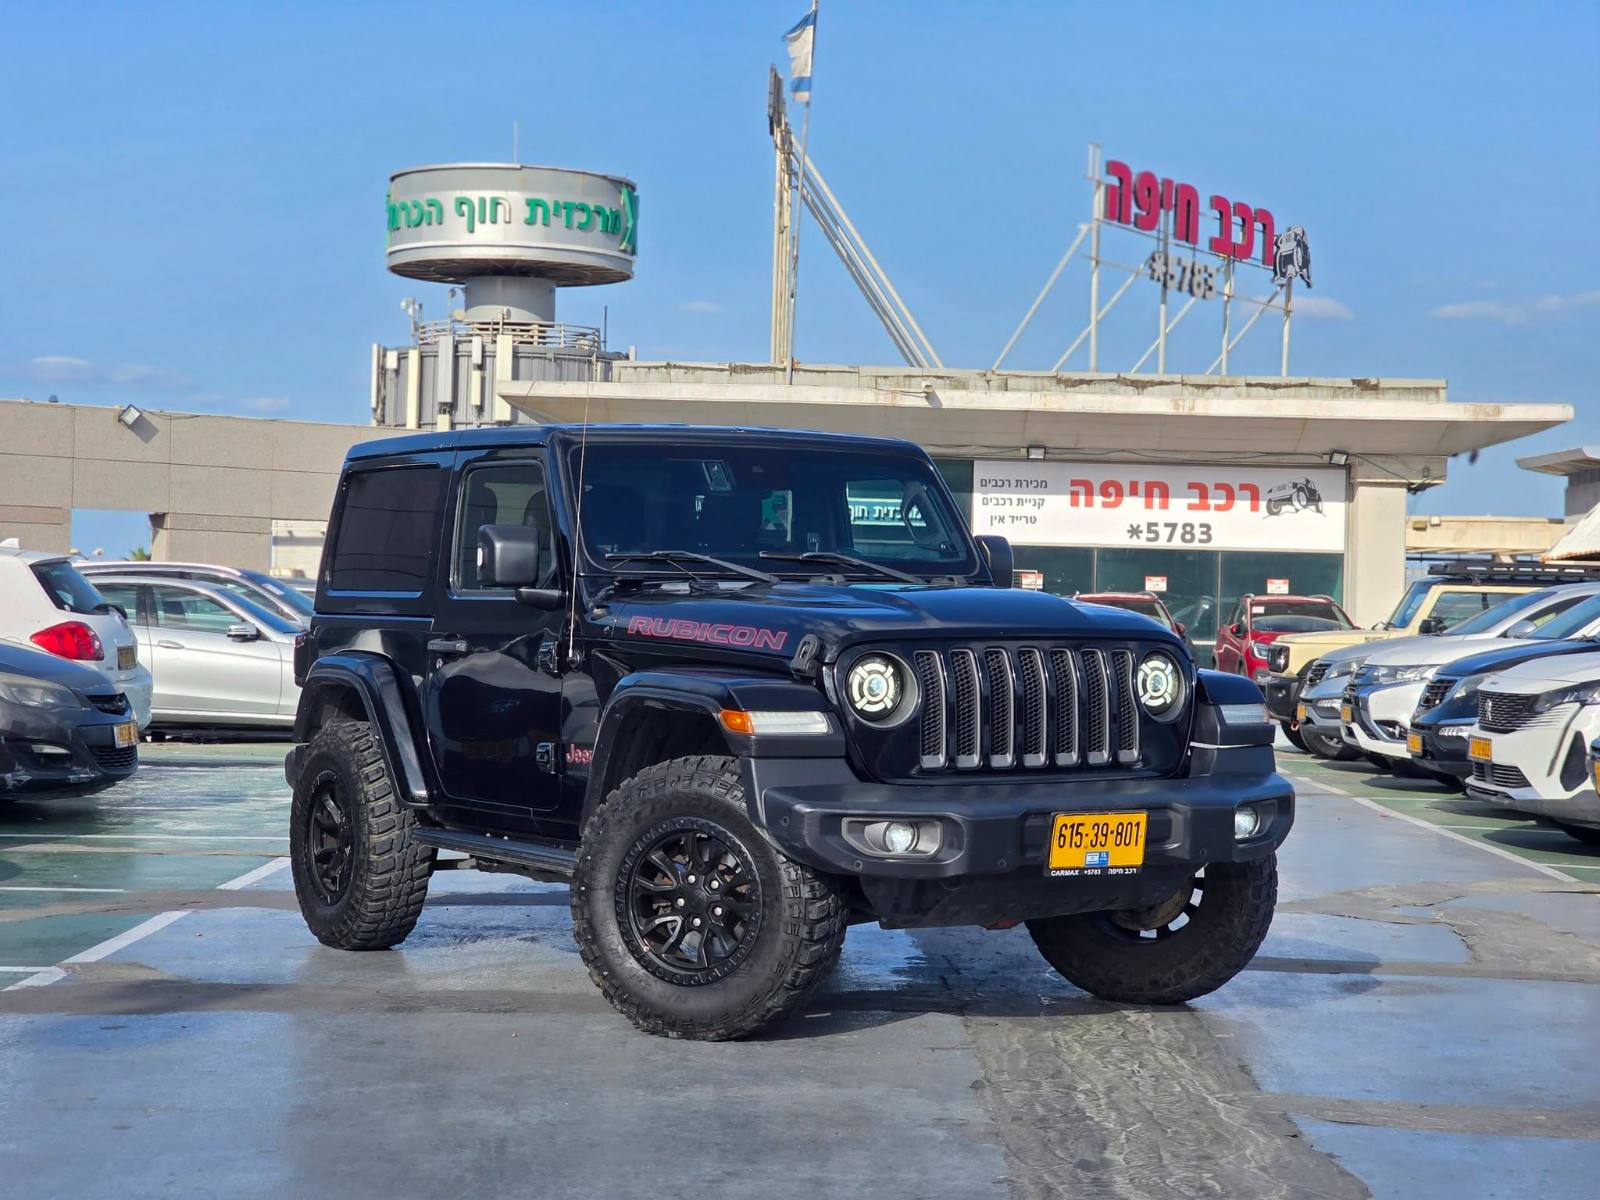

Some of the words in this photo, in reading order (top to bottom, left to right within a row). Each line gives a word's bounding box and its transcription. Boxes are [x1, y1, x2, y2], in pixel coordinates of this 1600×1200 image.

[454, 196, 512, 233] חוף
[524, 198, 621, 236] מרכזית
[1104, 160, 1200, 246] חיפה
[1209, 195, 1275, 267] רכב
[980, 478, 1012, 488] רכבים
[1014, 479, 1048, 489] מכירת
[1070, 478, 1169, 510] חיפה
[1187, 481, 1260, 512] רכב
[982, 496, 1013, 507] רכבים
[1016, 497, 1046, 510] קניית
[990, 514, 1006, 527] אין
[1009, 515, 1037, 525] טרייד
[627, 615, 788, 650] RUBICON
